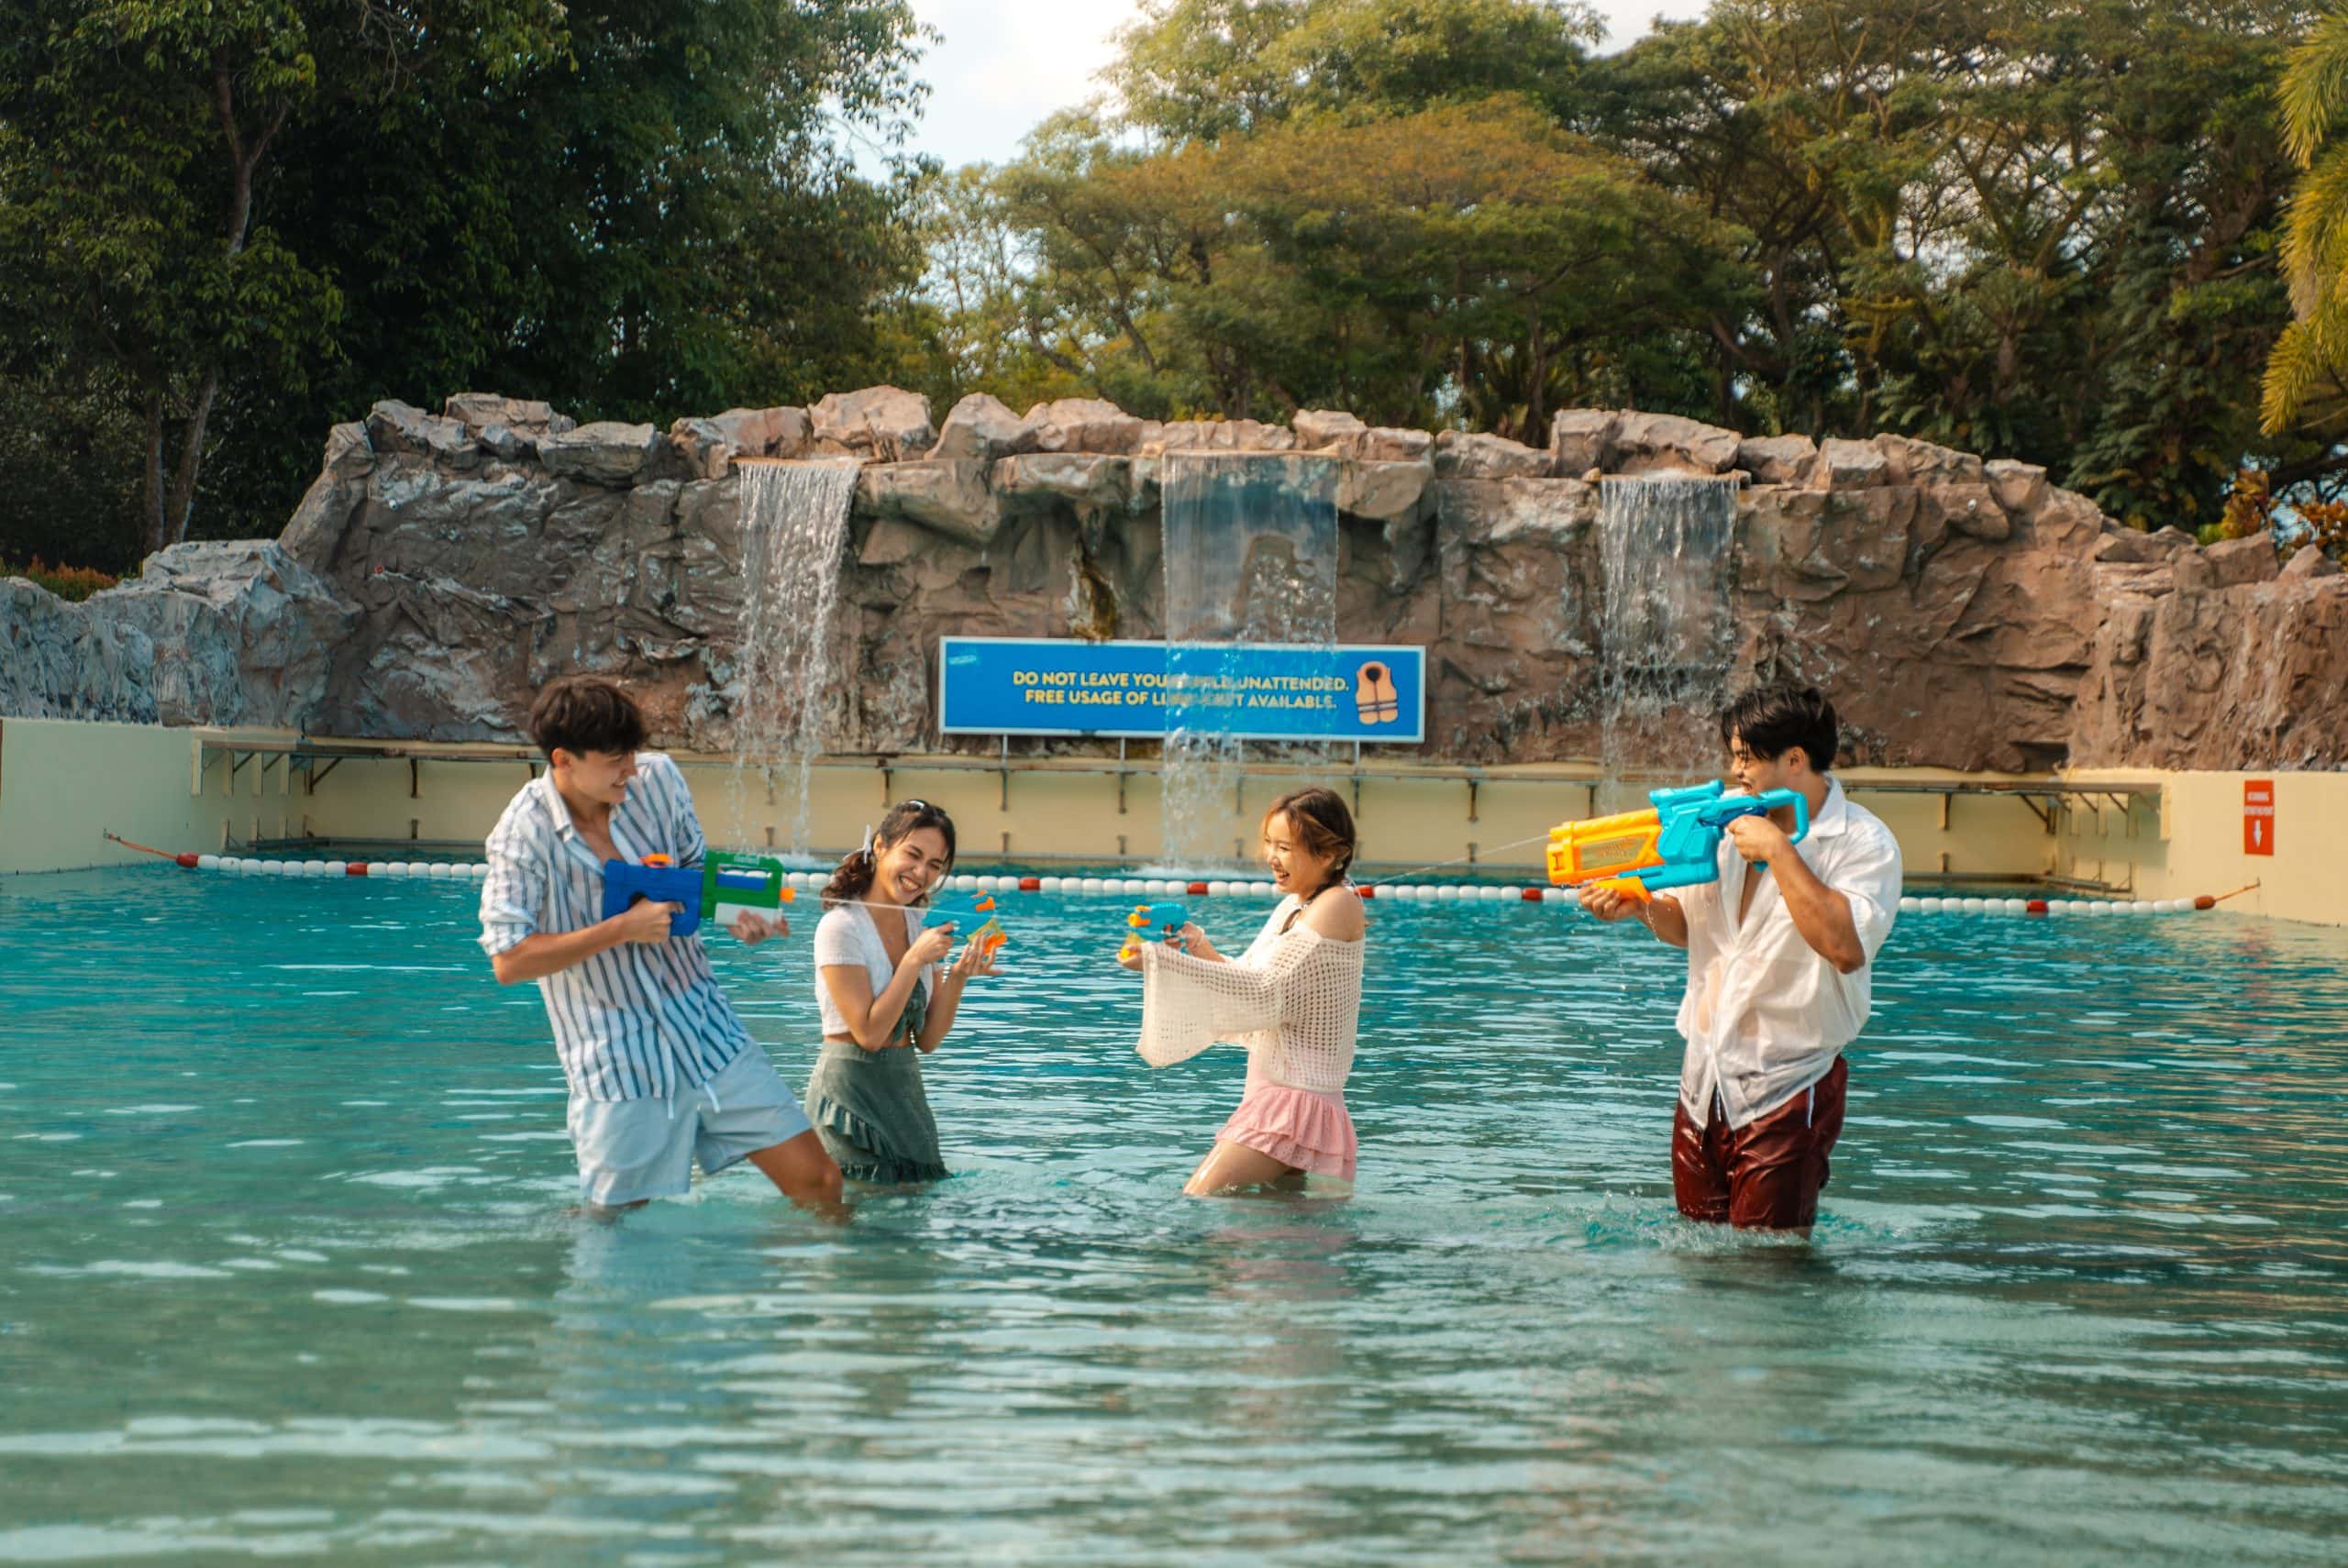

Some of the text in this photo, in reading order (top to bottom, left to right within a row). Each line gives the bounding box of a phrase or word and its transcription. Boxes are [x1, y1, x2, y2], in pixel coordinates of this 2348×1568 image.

[1013, 671, 1038, 686] DO
[1042, 671, 1077, 686] NOT
[1080, 672, 1128, 687] LEAVE
[1025, 690, 1065, 703] FREE
[1069, 690, 1122, 704] USAGE
[1125, 691, 1148, 705] OF
